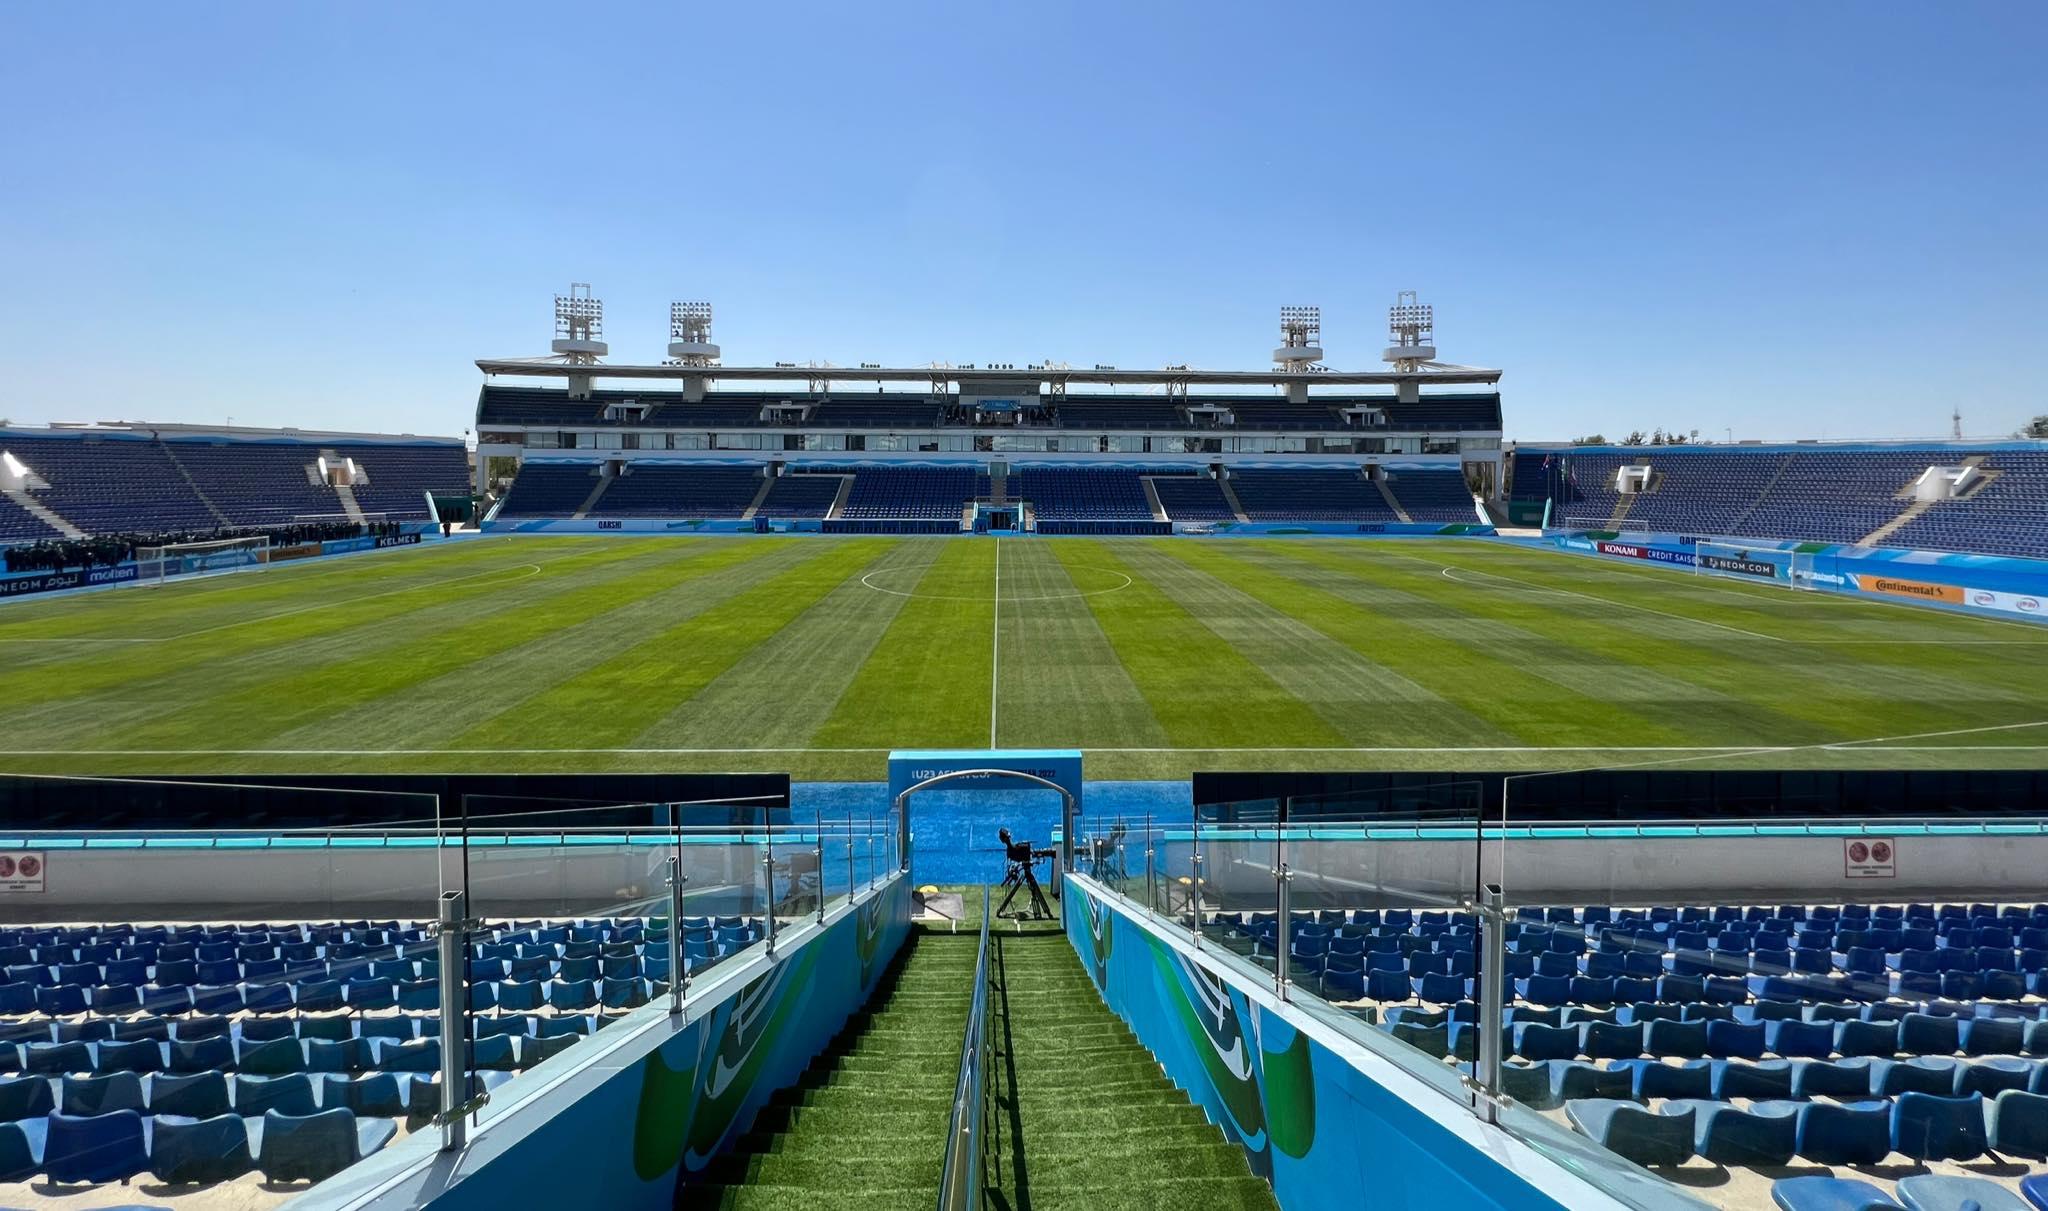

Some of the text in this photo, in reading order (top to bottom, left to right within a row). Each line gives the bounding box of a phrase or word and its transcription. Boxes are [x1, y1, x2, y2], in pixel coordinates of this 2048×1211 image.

[380, 535, 410, 547] KELME
[1604, 543, 1638, 557] KONAMI
[1647, 550, 1703, 565] CREDIT SAISON
[1720, 559, 1770, 574] NEOM.COM
[89, 567, 134, 582] molten
[0, 580, 41, 592] NEOM
[1875, 579, 1935, 596] Continental
